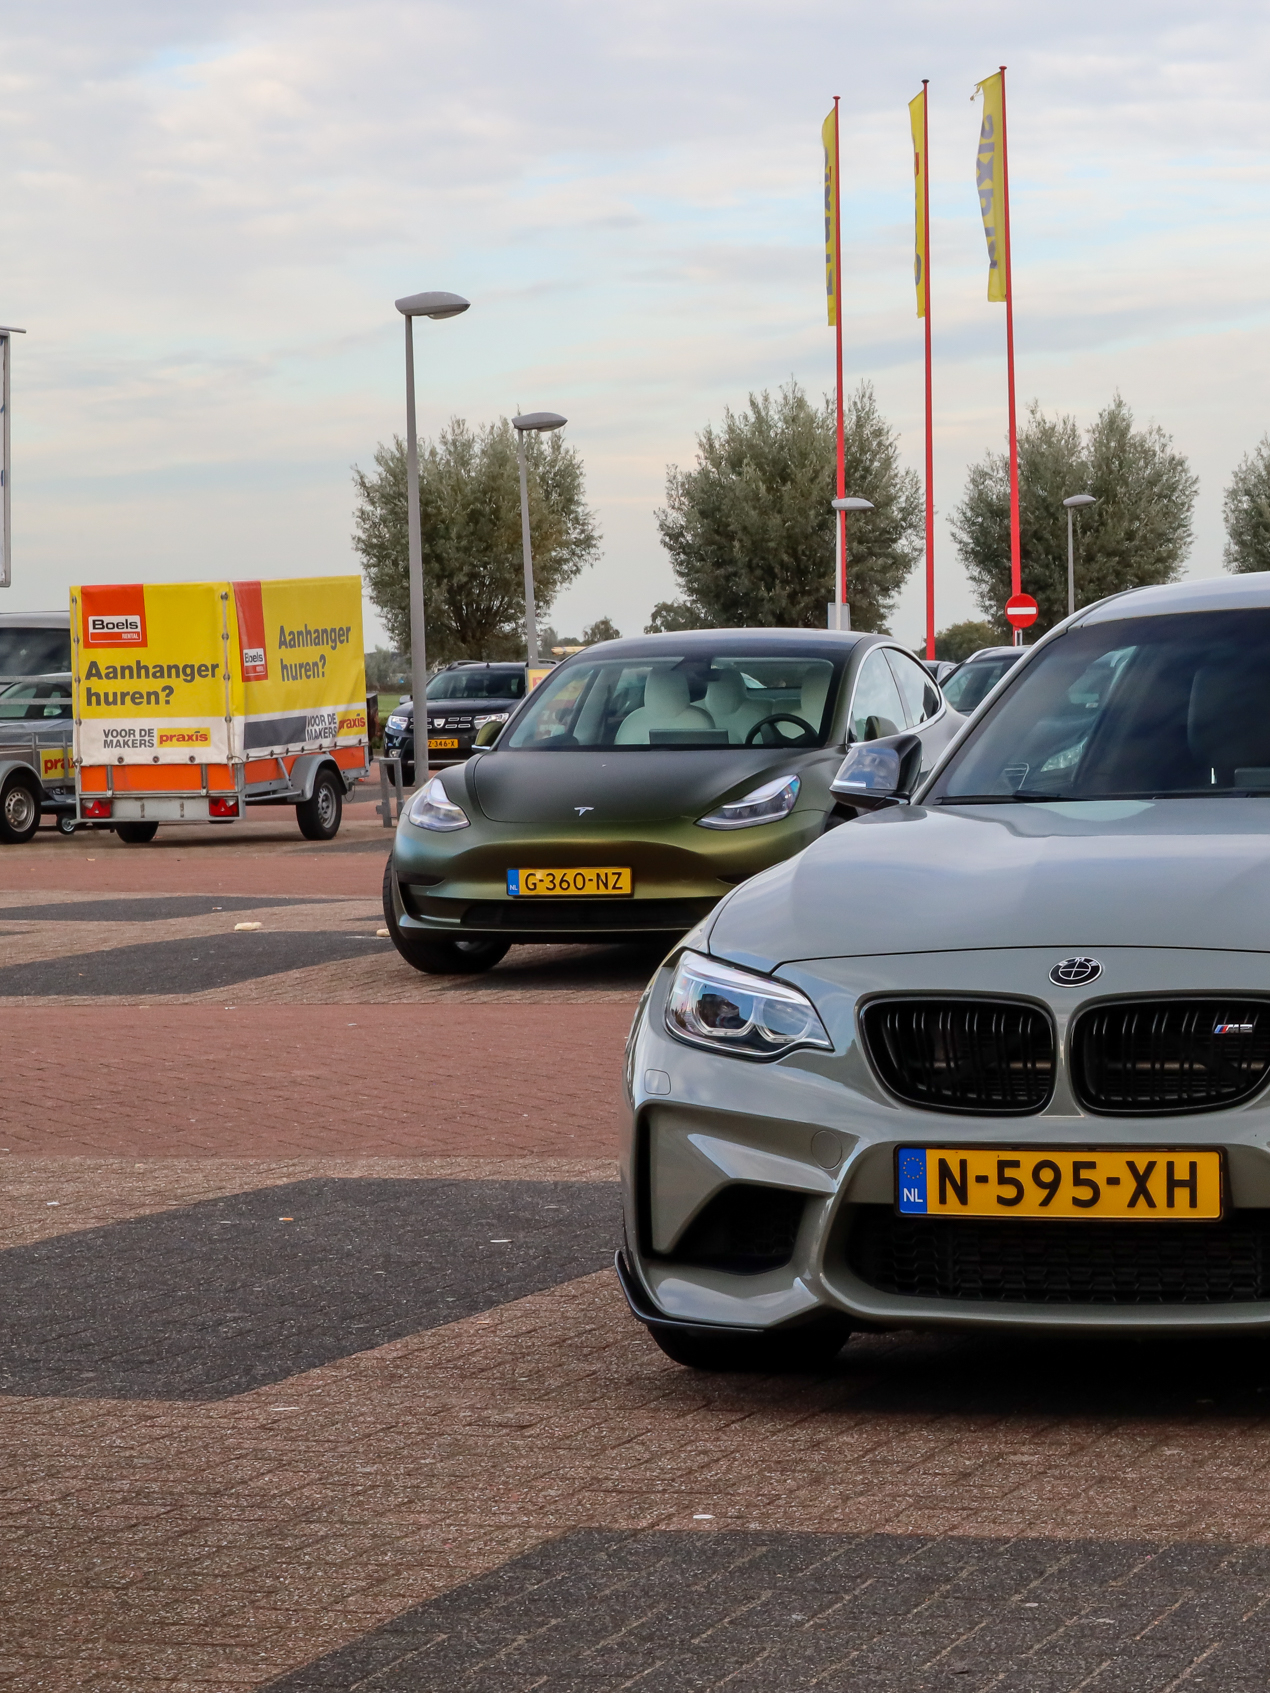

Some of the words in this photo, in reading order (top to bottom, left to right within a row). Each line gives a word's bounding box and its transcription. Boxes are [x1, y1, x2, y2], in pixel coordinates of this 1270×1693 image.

[92, 618, 139, 630] Boels
[278, 623, 352, 651] Aanhanger
[244, 651, 264, 663] Boels
[84, 660, 220, 684] Aanhanger
[280, 653, 327, 682] huren?
[85, 685, 175, 707] huren?
[327, 712, 337, 726] DE
[103, 728, 136, 738] VOOR
[139, 728, 155, 738] DE
[159, 731, 208, 745] praxis
[306, 726, 338, 741] MAKERS
[103, 739, 155, 749] MAKERS
[525, 872, 623, 891] G-360-NZ
[903, 1187, 924, 1203] NL
[937, 1157, 1198, 1209] N-595-XH
